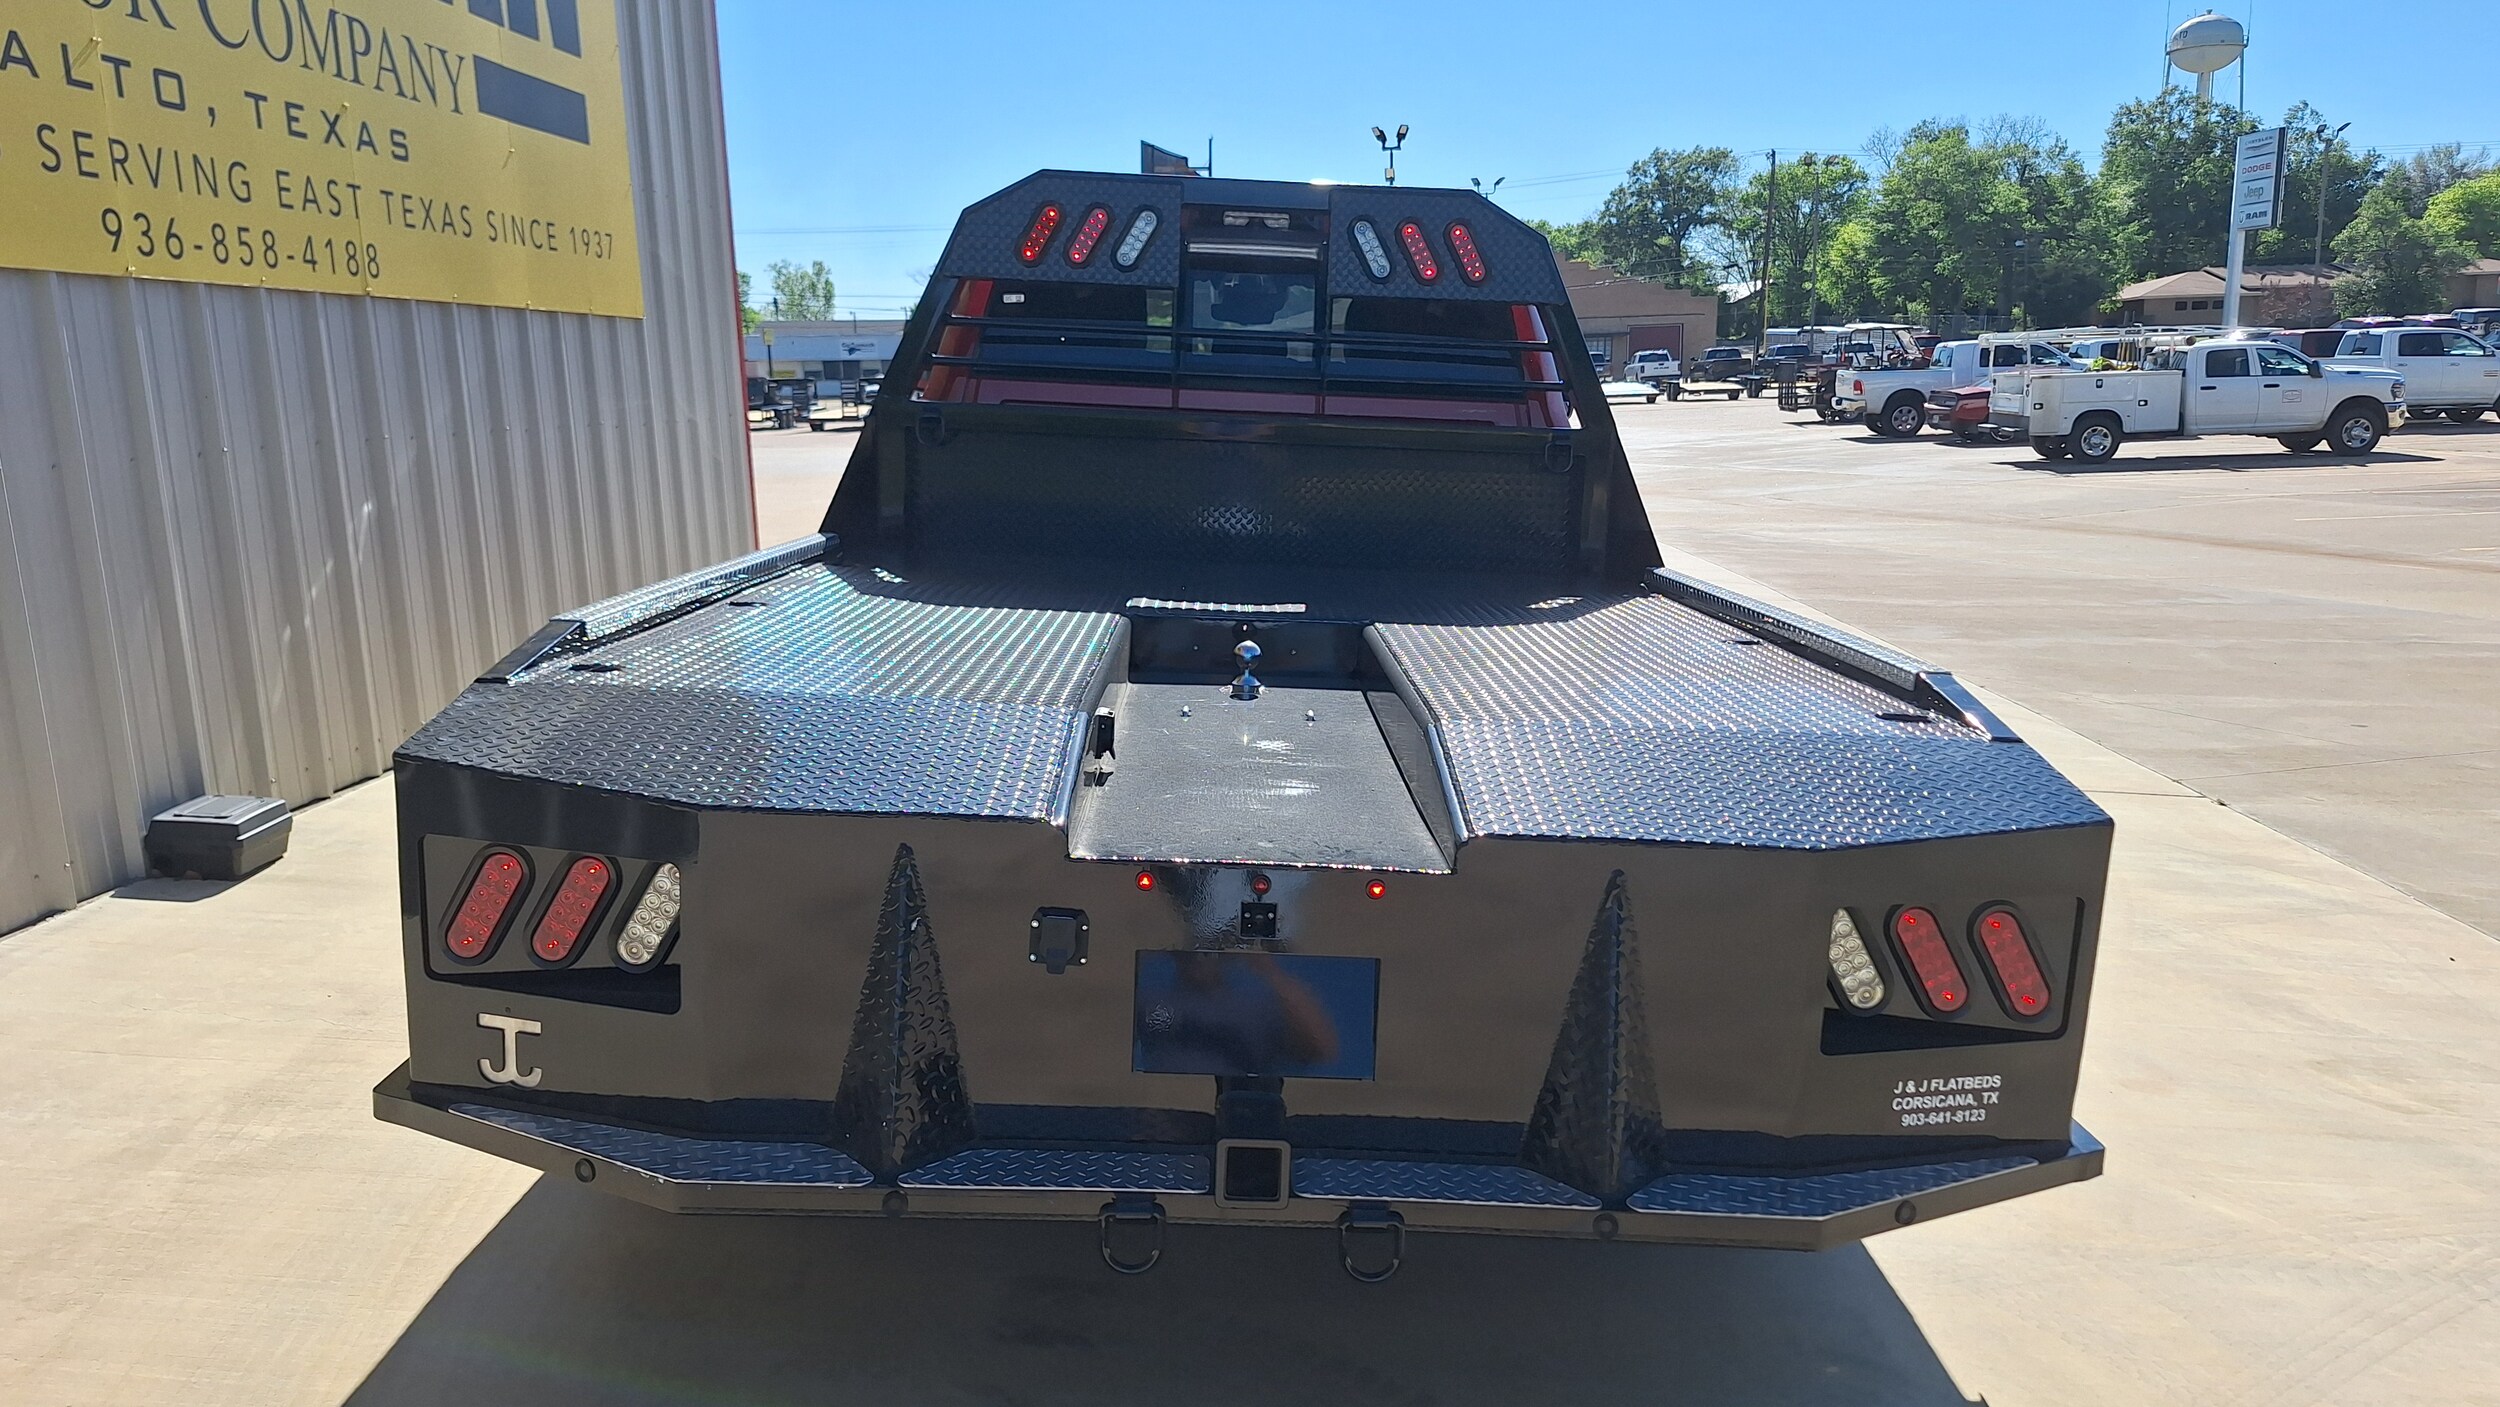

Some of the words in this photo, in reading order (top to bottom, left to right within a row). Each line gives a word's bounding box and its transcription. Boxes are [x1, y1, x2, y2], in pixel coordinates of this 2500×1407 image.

[0, 29, 217, 128] ALTO,
[243, 90, 410, 162] TEXAS
[2242, 162, 2272, 175] DODGE
[36, 123, 252, 203] SERVING
[275, 169, 362, 220] EAST
[380, 189, 473, 239] TEXAS
[486, 210, 559, 252] SINCE
[569, 226, 613, 260] 1937
[2244, 185, 2264, 200] Jeep
[2245, 210, 2268, 220] RAM
[101, 207, 380, 279] 936-858-4188
[1893, 1081, 1903, 1094] J
[1905, 1080, 1916, 1093] &
[1918, 1079, 1928, 1092] J
[1930, 1075, 2002, 1092] FLATBEDS
[1892, 1093, 1978, 1111] CORSICANA,
[1981, 1091, 1999, 1104] TX
[1901, 1108, 1986, 1127] 903-641-8123
